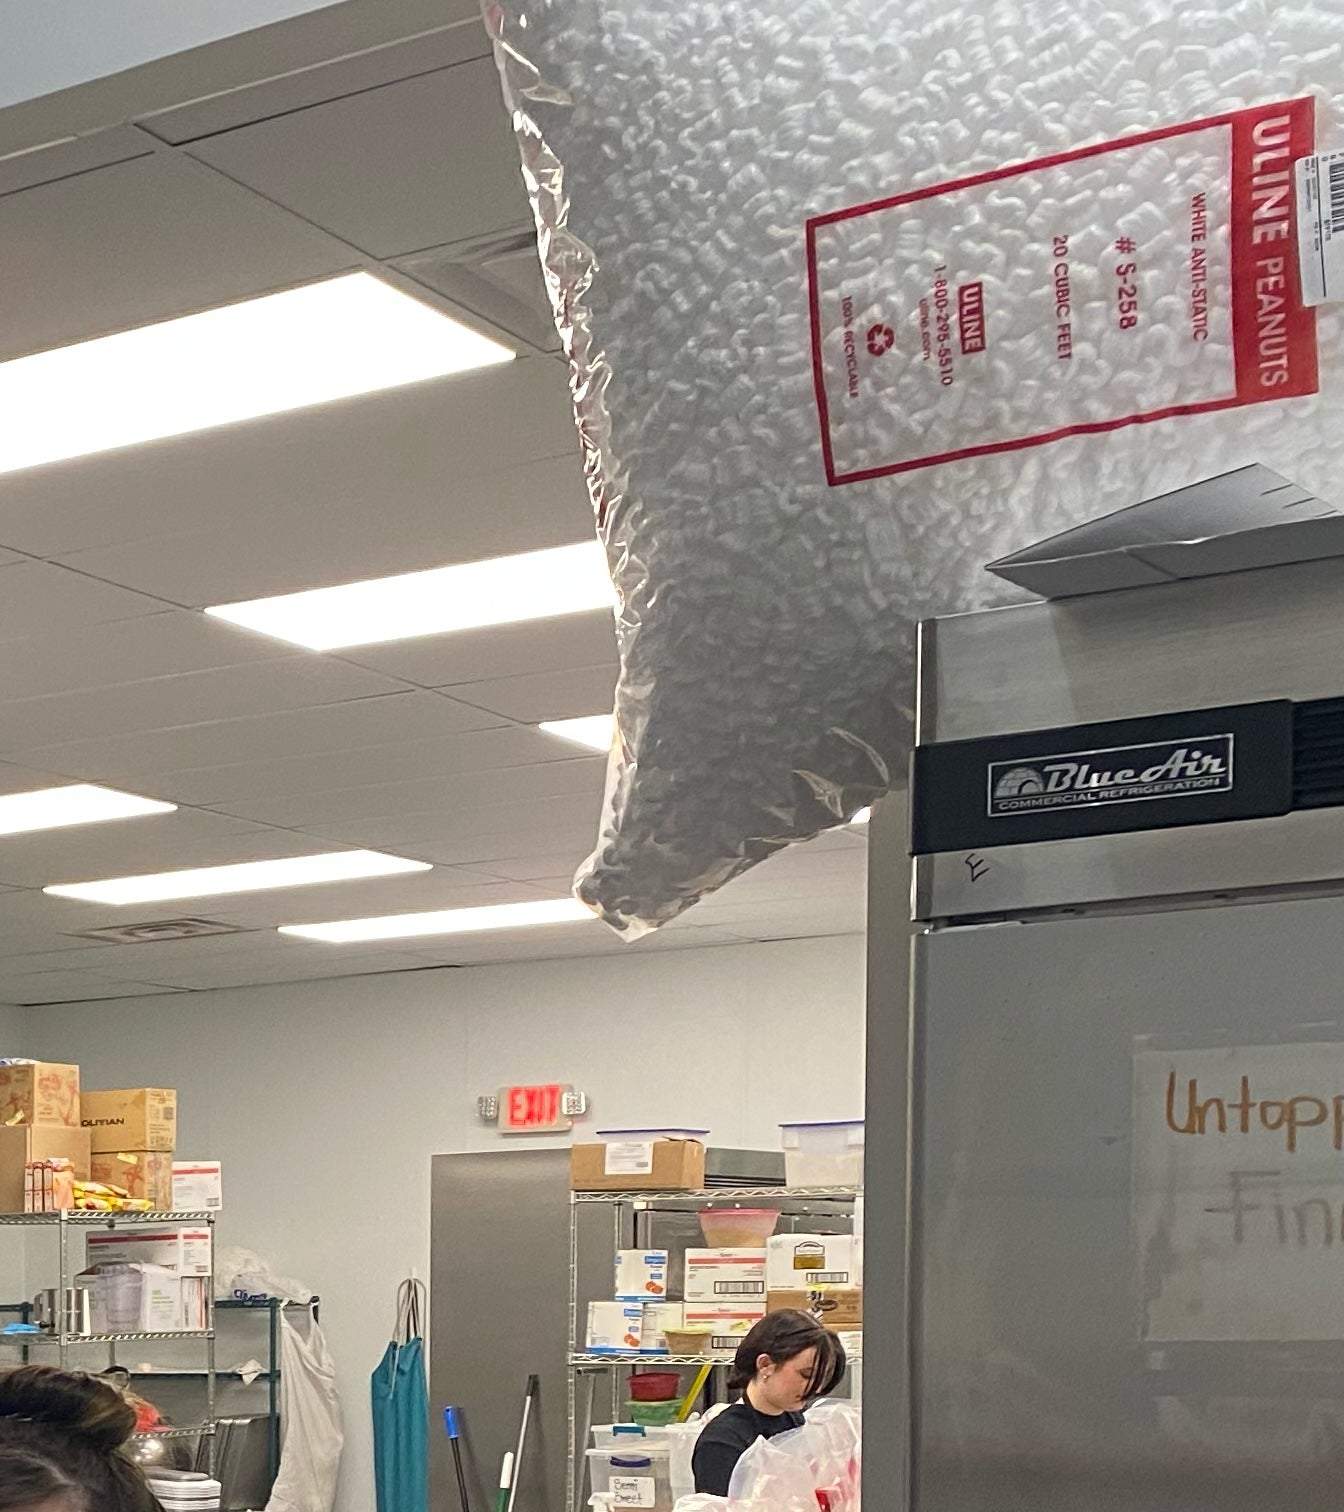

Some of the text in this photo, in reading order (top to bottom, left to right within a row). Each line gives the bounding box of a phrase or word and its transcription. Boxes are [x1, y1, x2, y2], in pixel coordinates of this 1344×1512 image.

[1115, 236, 1138, 330] # S-258
[1191, 192, 1208, 342] WHITE ANTI-STATIC
[1251, 114, 1292, 387] ULINE PEANUTS
[919, 298, 931, 361] uline.com
[933, 264, 954, 387] 1-800-295-5510
[962, 285, 983, 352] ULINE
[1053, 234, 1072, 360] 20 CUBIC FEET
[843, 330, 860, 399] RECYCLABLE
[998, 777, 1221, 811] COMMERCIAL REFRIGERATION
[508, 1084, 562, 1127] EXIT
[1166, 1070, 1344, 1154] Untop
[1203, 1170, 1344, 1250] Fin
